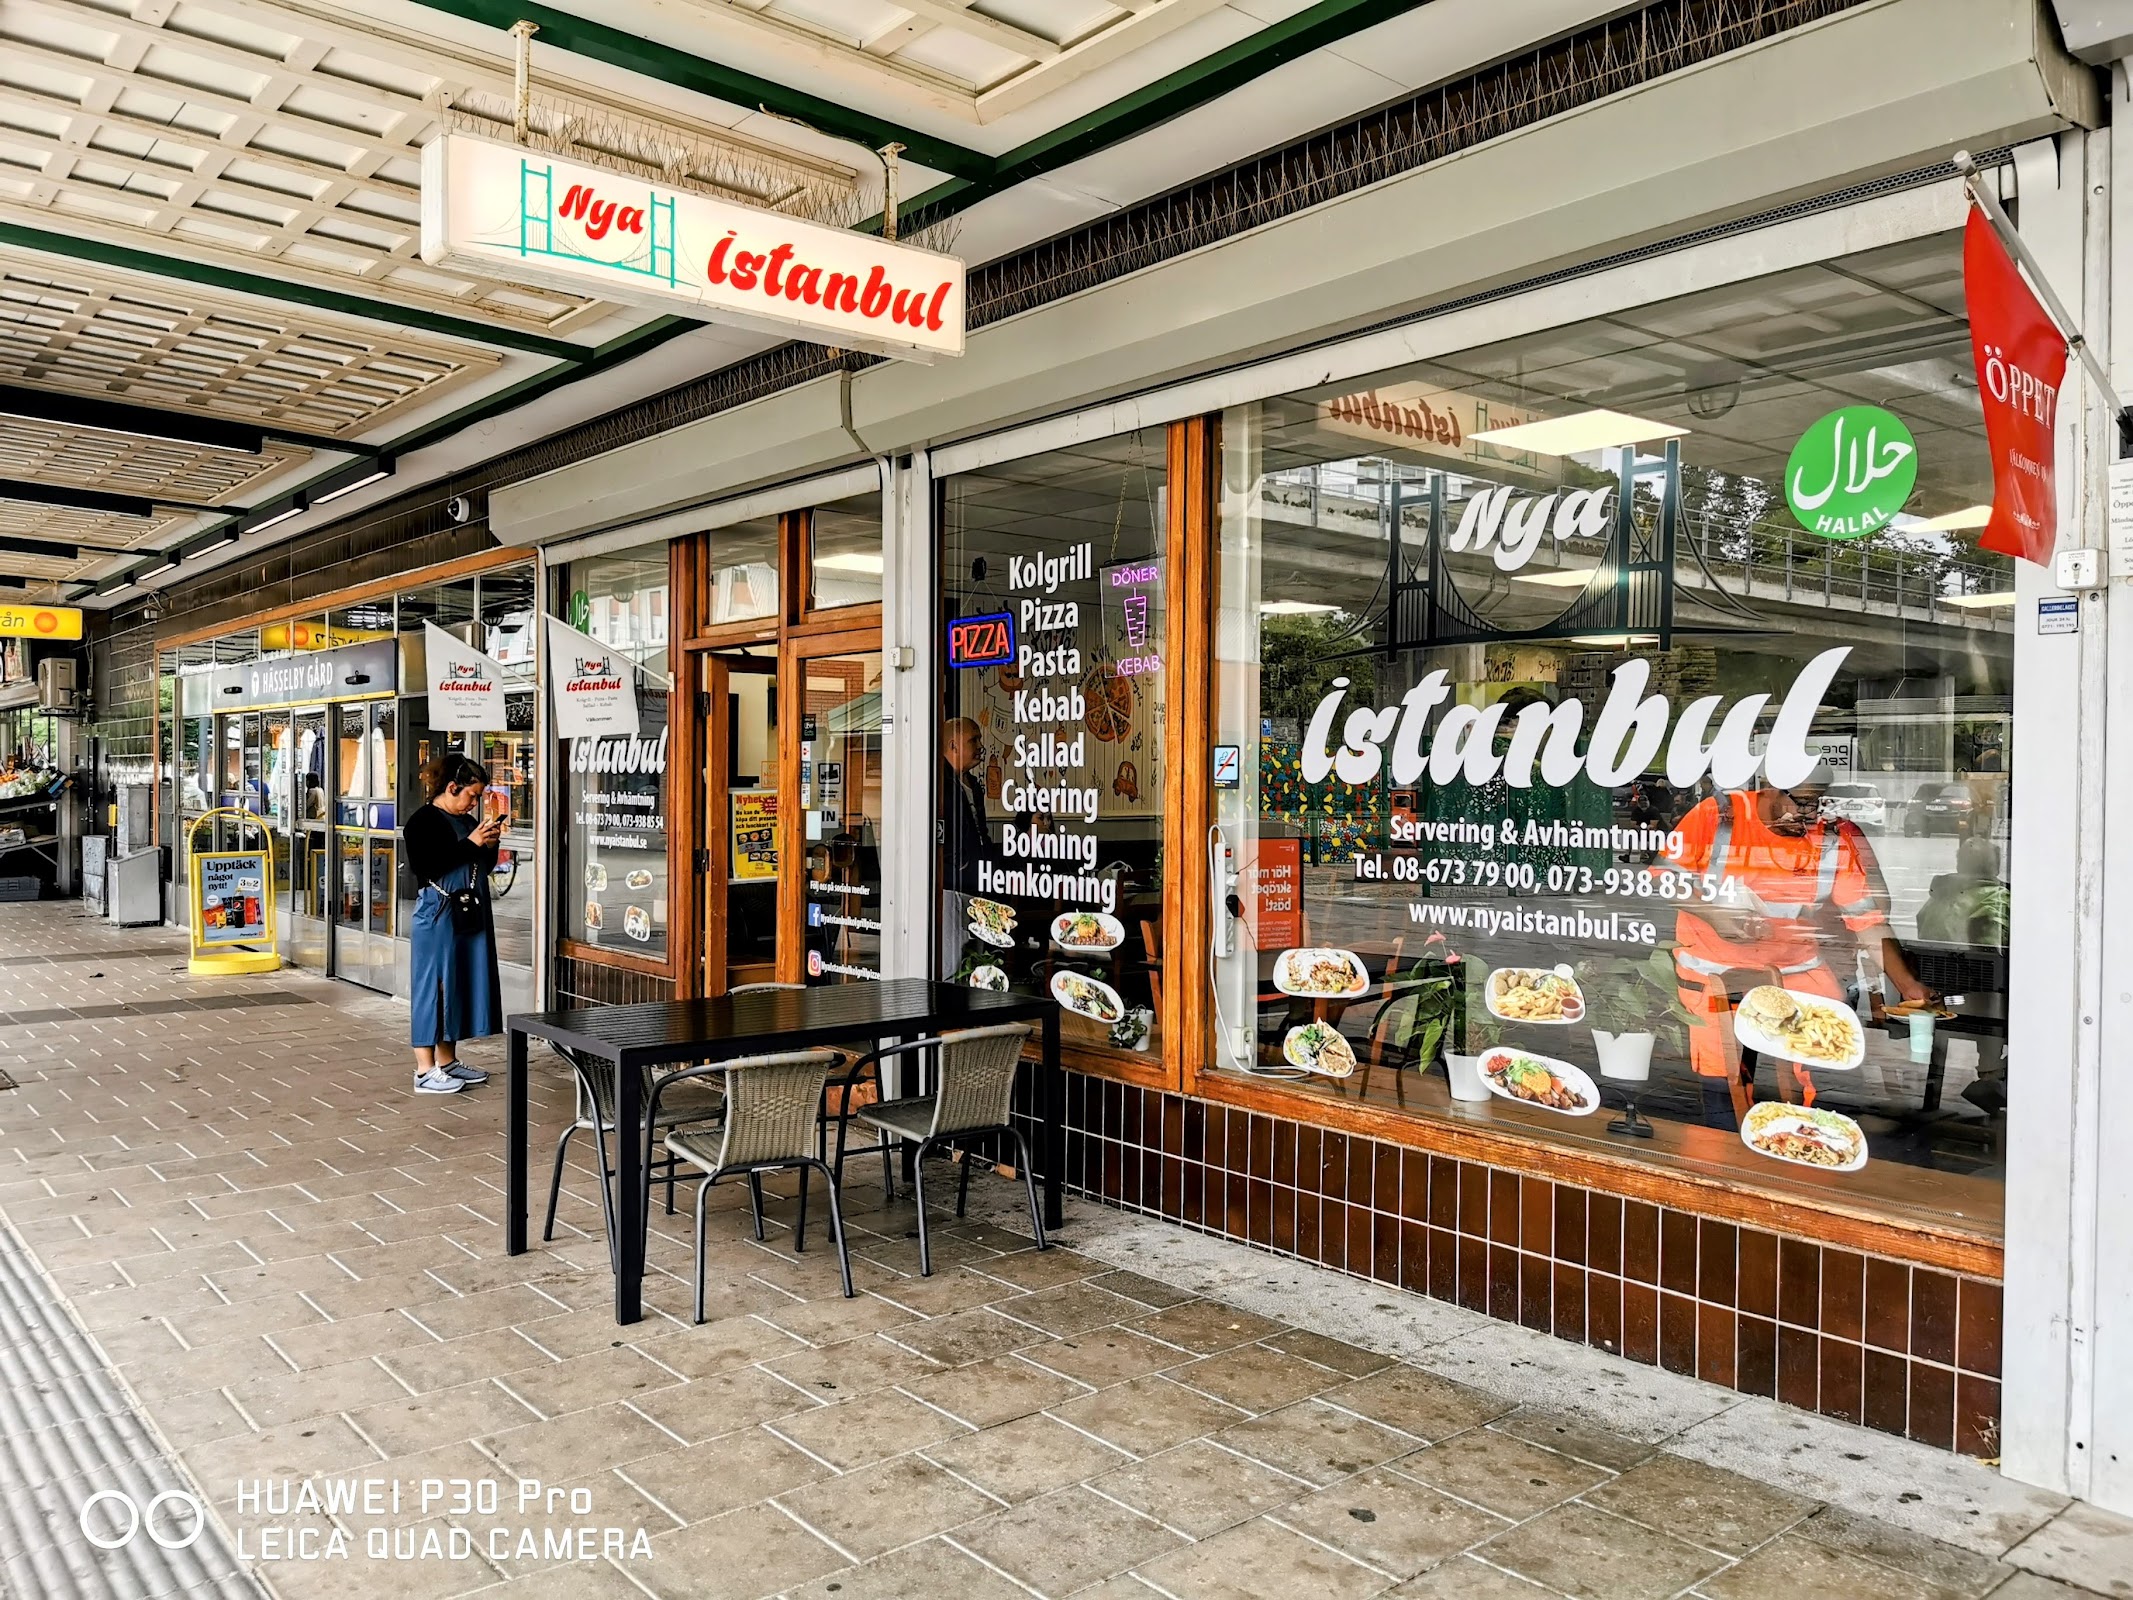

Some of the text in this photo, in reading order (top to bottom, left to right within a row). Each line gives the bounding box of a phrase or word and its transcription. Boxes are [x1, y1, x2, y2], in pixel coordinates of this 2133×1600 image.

[558, 184, 646, 240] Nya
[707, 230, 953, 332] istanbul
[1984, 344, 2056, 430] ÖPPET
[1792, 416, 1913, 510] حلال
[1450, 485, 1614, 572] Nya
[1815, 506, 1889, 534] HALAL
[1009, 542, 1092, 594] Kolgrill
[1112, 566, 1159, 587] DÖNER
[0, 611, 24, 627] ån
[1020, 597, 1079, 633] Pizza
[952, 622, 1010, 659] PIZZA
[262, 665, 305, 694] HÄSSELBY
[307, 657, 333, 688] GÅRD
[585, 661, 602, 670] Nya
[1018, 644, 1081, 679] Pasta
[1116, 655, 1161, 675] KEBAB
[439, 680, 492, 692] istanbul
[566, 677, 622, 692] istanbul
[1014, 685, 1086, 724] Kebab
[1300, 646, 1854, 791] istanbul
[1014, 732, 1085, 768] Sallad
[582, 790, 610, 808] Servering
[617, 791, 655, 810] Avhämtning
[1001, 778, 1098, 824] Catering
[590, 834, 647, 849] www.nyaistanbul.se
[1002, 823, 1097, 871] Bokning
[1390, 815, 1684, 860] Servering & Avhämtning
[206, 859, 256, 872] Upptäck
[208, 873, 233, 882] något
[1353, 852, 1738, 904] Tel. 08-673 79 00, 073-938 85 54
[208, 882, 227, 891] nytt!
[978, 860, 1117, 914] Hemkörning
[1409, 903, 1657, 944] www.nyaistanbul.se
